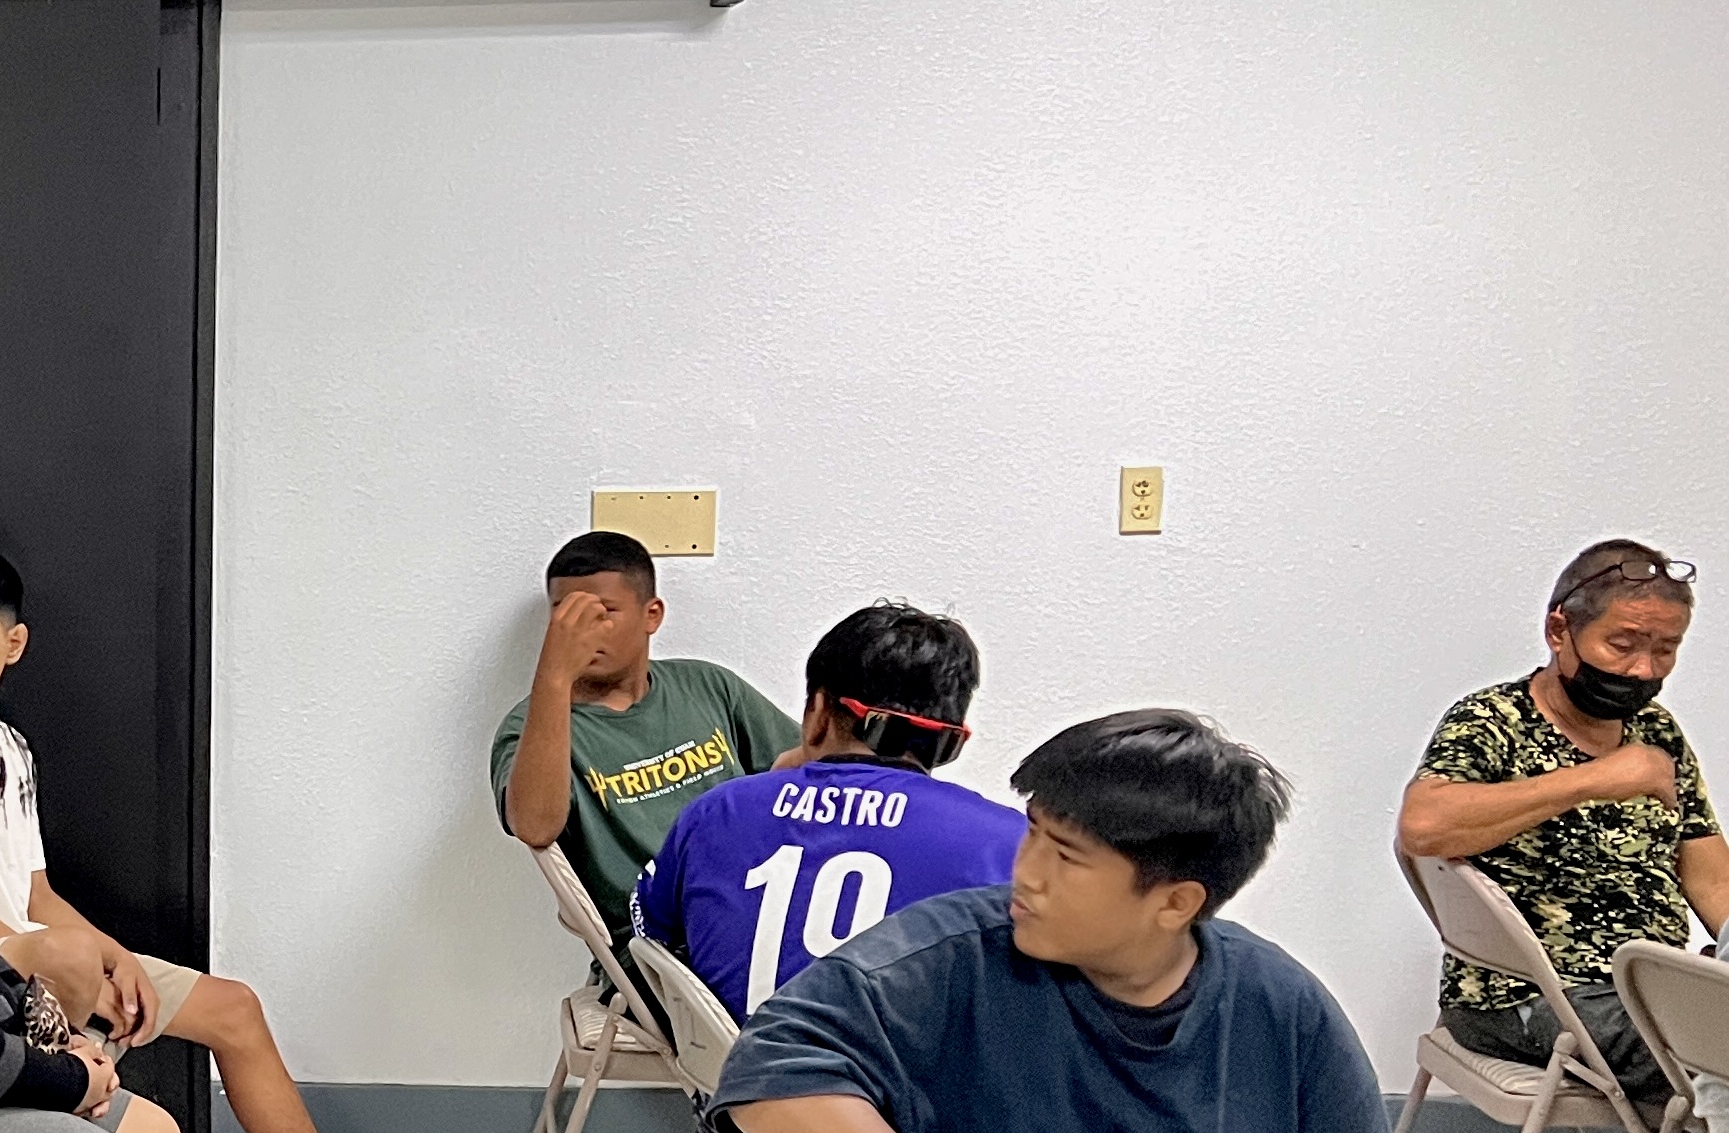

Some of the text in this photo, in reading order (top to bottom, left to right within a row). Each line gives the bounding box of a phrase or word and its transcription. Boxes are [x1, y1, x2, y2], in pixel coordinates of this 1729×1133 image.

[604, 741, 723, 798] TRITONS
[772, 783, 908, 828] CASTRO
[744, 844, 893, 1016] 10
